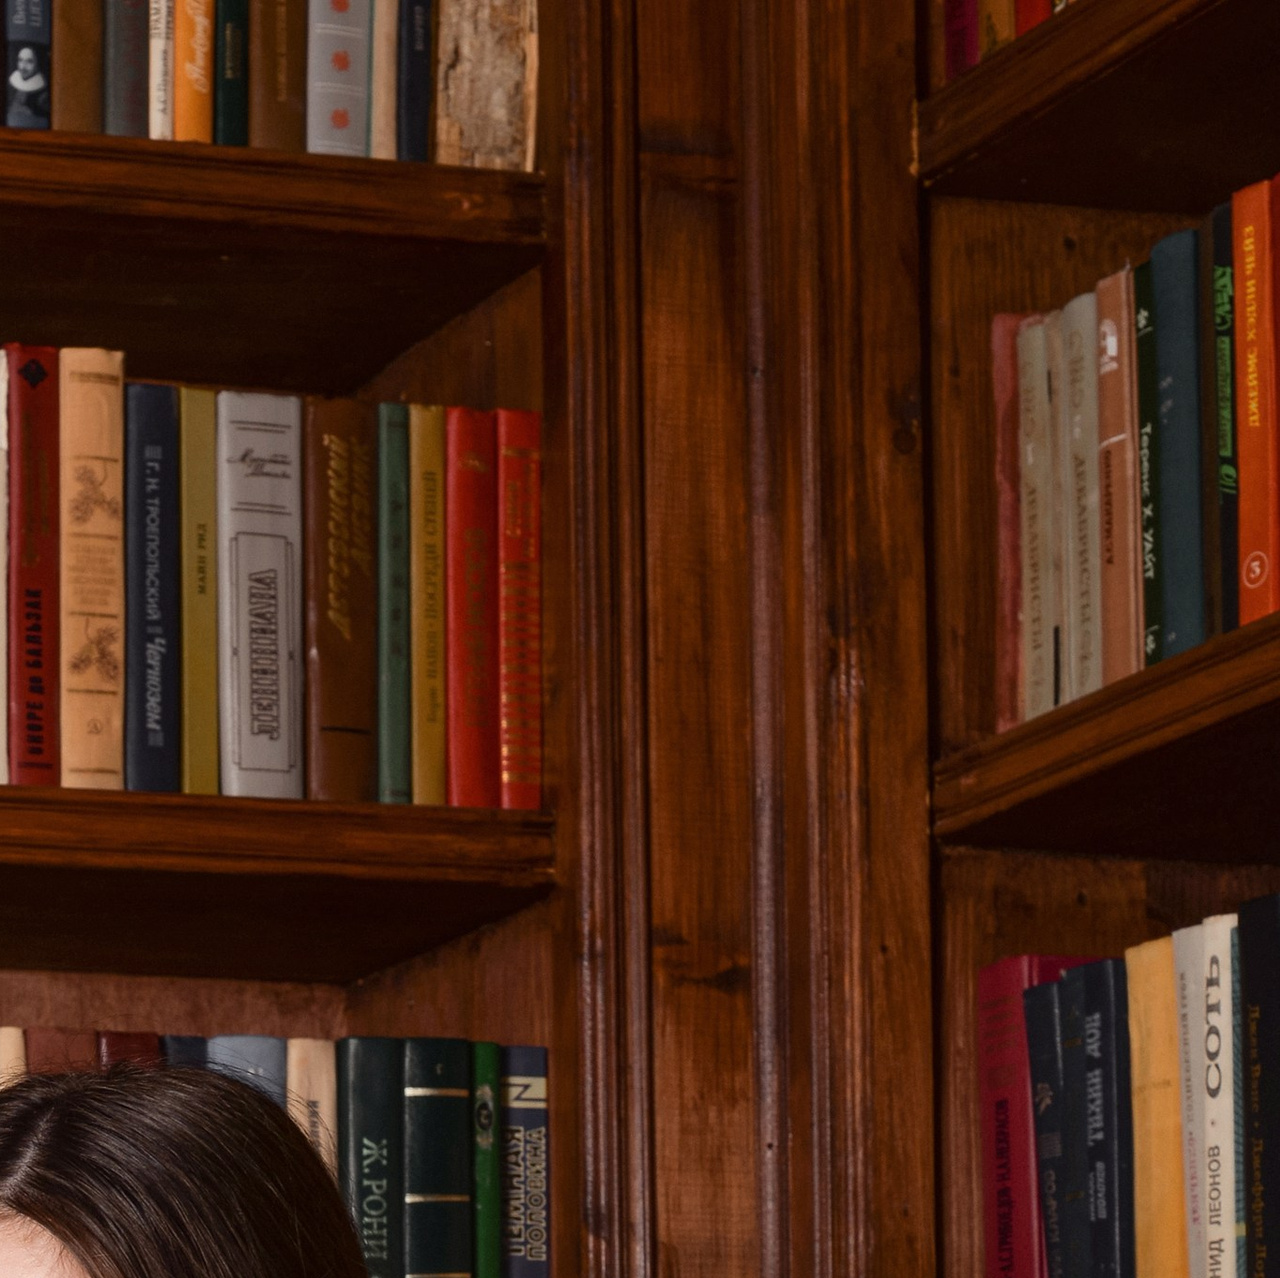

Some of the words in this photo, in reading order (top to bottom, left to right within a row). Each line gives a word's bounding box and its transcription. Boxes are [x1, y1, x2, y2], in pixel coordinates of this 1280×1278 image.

[145, 496, 162, 621] ТРОЕПОЛЬСКИЙ
[24, 588, 43, 669] БАЛЬЗАК
[1085, 1011, 1103, 1058] ДОН
[1203, 954, 1223, 1099] СОТЬ
[1086, 1068, 1105, 1146] ТИХИЙ
[361, 1137, 388, 1174] Ж.
[525, 1125, 548, 1262] ПОЛОВИНА
[1207, 1144, 1224, 1226] ЛЕОНОВ
[361, 1178, 388, 1260] РОНИ
